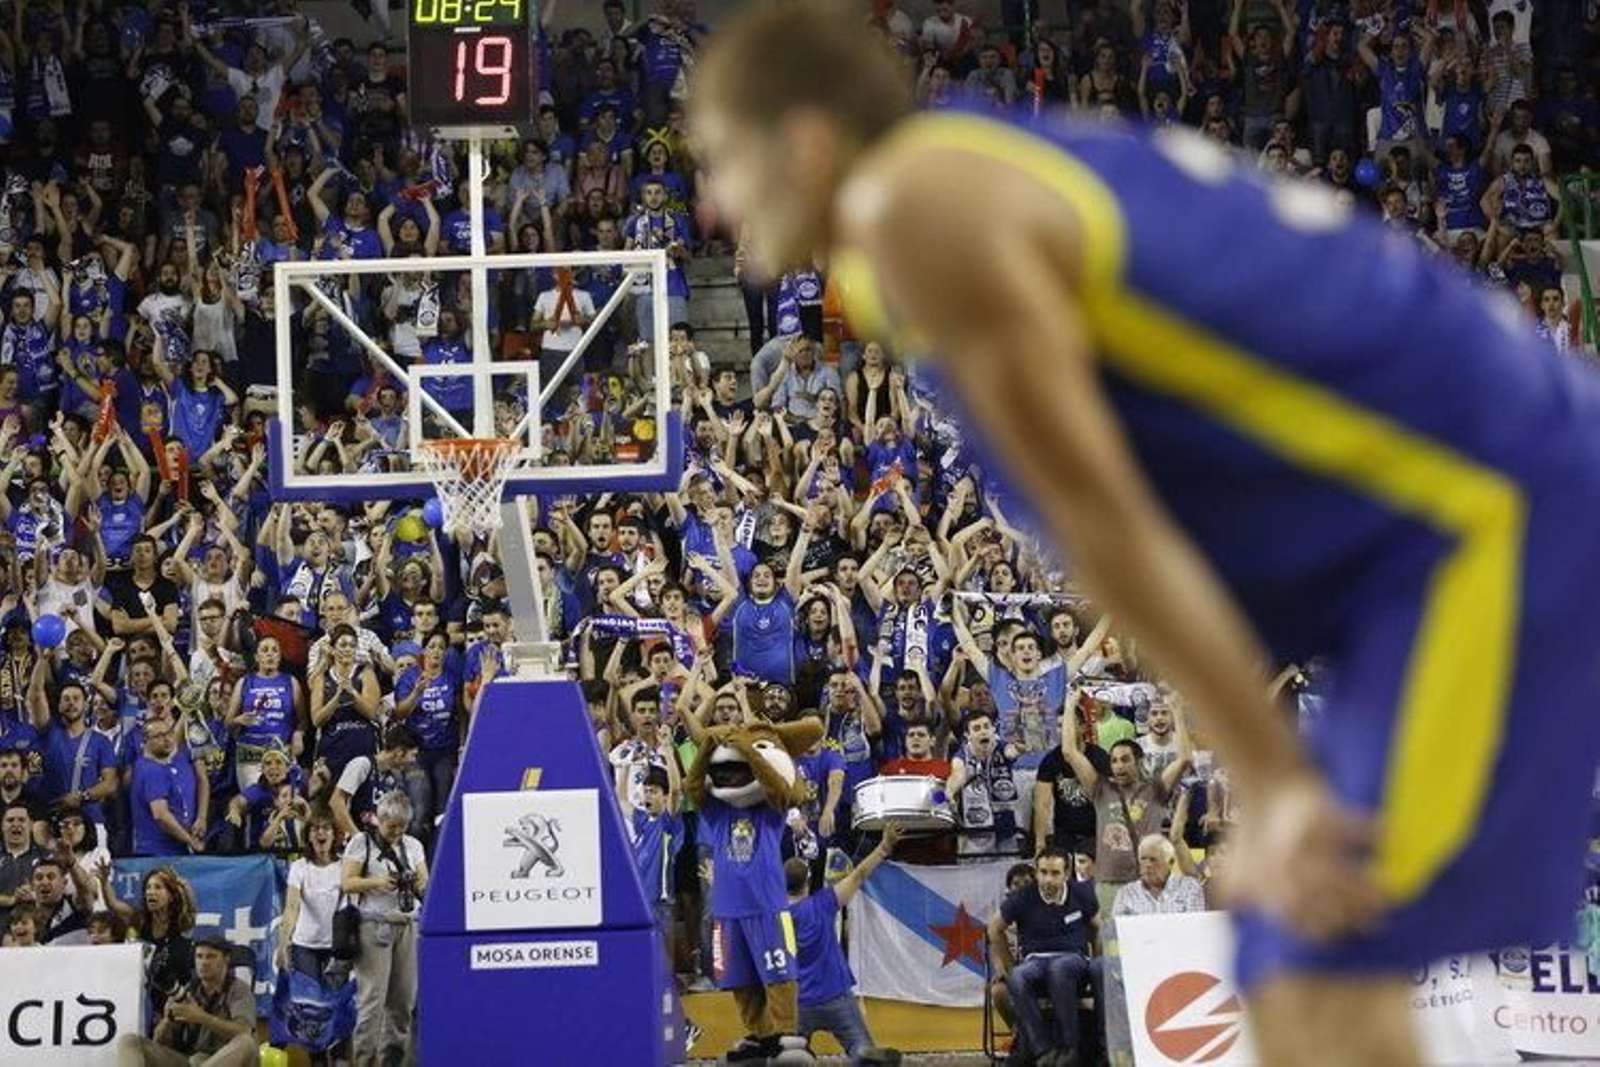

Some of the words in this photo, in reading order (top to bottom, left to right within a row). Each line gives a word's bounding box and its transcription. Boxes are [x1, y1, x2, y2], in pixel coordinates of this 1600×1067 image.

[455, 37, 512, 105] 19
[472, 887, 597, 903] PEUGEOT
[476, 950, 525, 964] MOSA
[528, 946, 594, 961] ORENSE
[764, 948, 787, 971] 13
